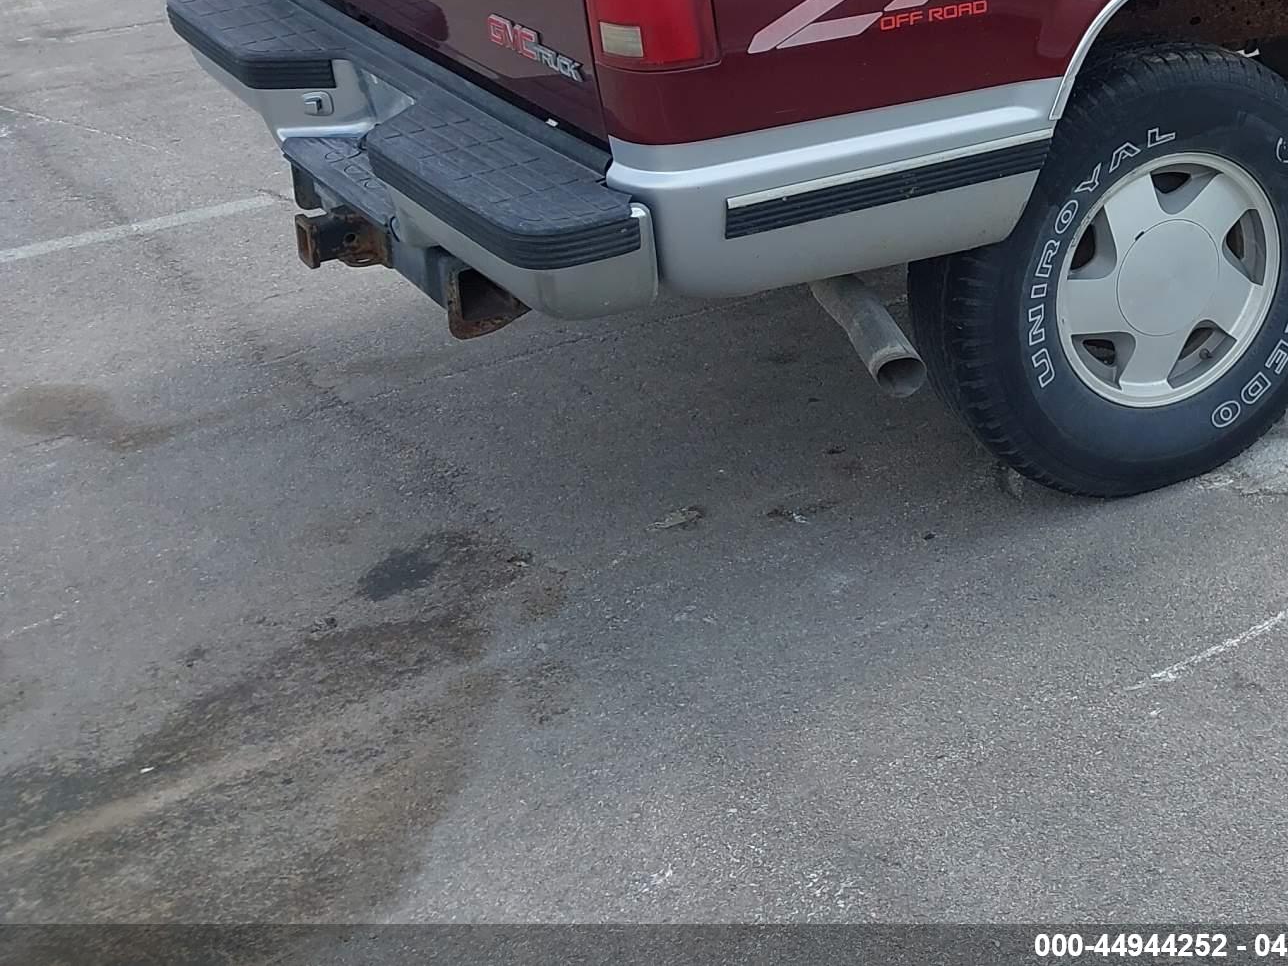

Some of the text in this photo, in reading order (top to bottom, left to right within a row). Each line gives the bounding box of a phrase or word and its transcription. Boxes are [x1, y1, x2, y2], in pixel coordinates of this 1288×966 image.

[487, 14, 537, 60] GMC
[880, 0, 988, 31] OFF ROAD
[532, 43, 584, 83] TRUCK
[1026, 126, 1177, 389] UNIROYAL
